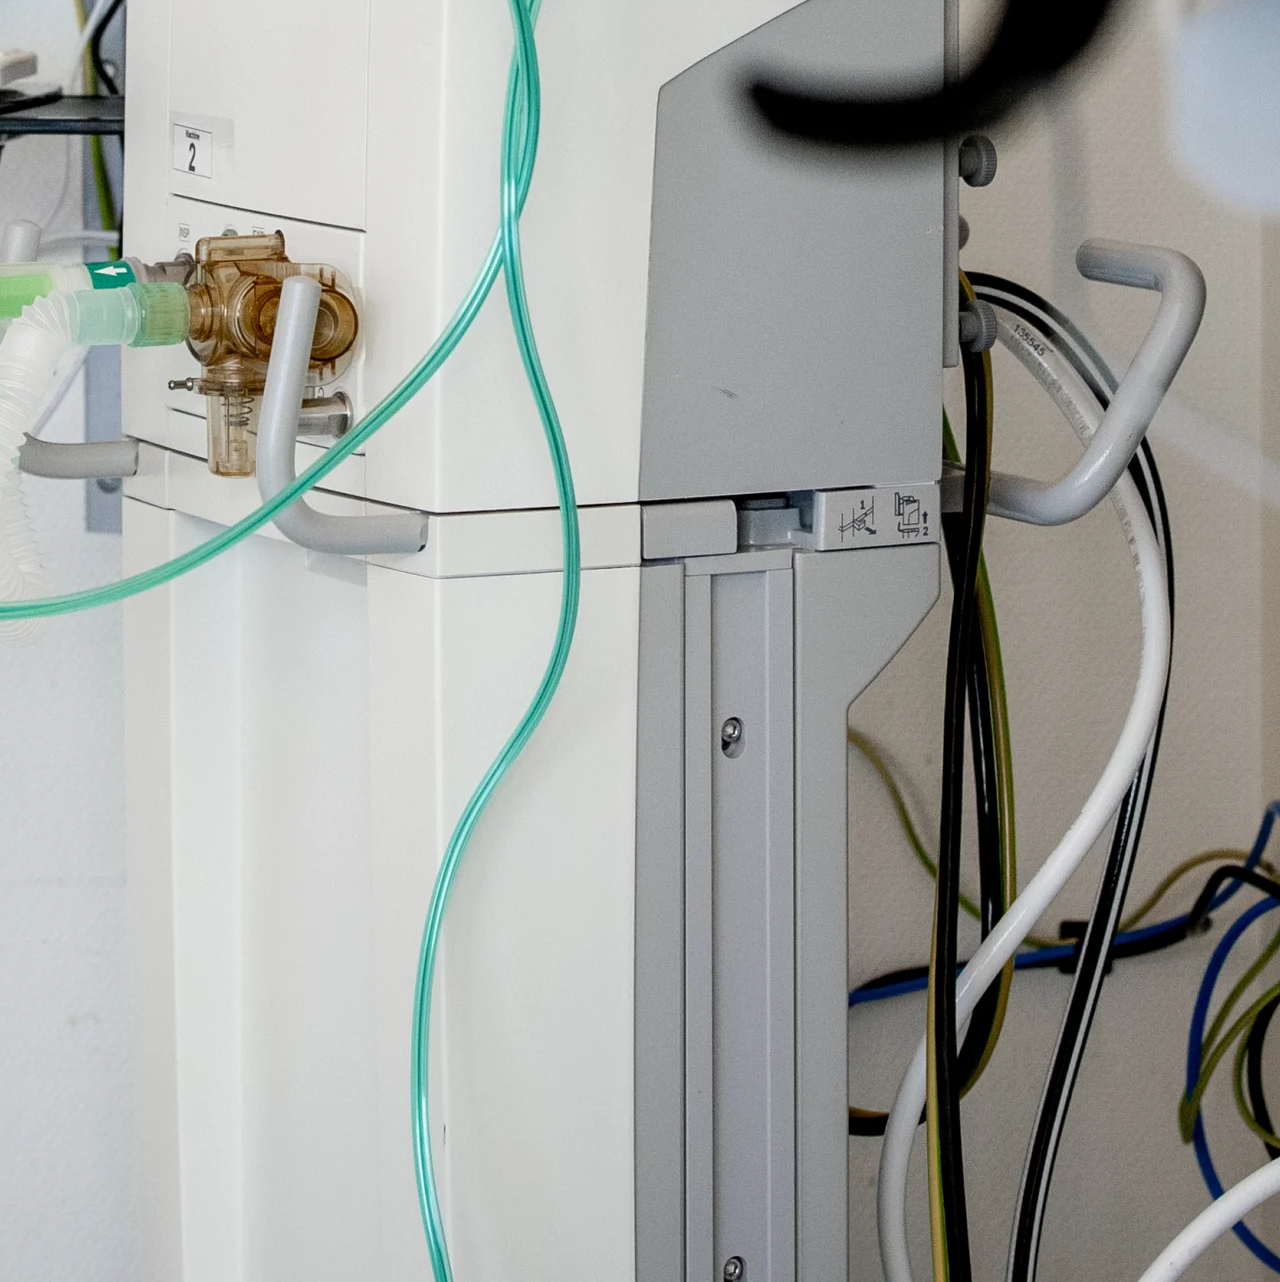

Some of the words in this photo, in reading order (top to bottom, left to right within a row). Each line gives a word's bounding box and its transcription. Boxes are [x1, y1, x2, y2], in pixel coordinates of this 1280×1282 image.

[188, 142, 196, 172] 2
[1013, 324, 1047, 357] 135545
[860, 499, 866, 510] 1
[922, 526, 929, 536] 2
